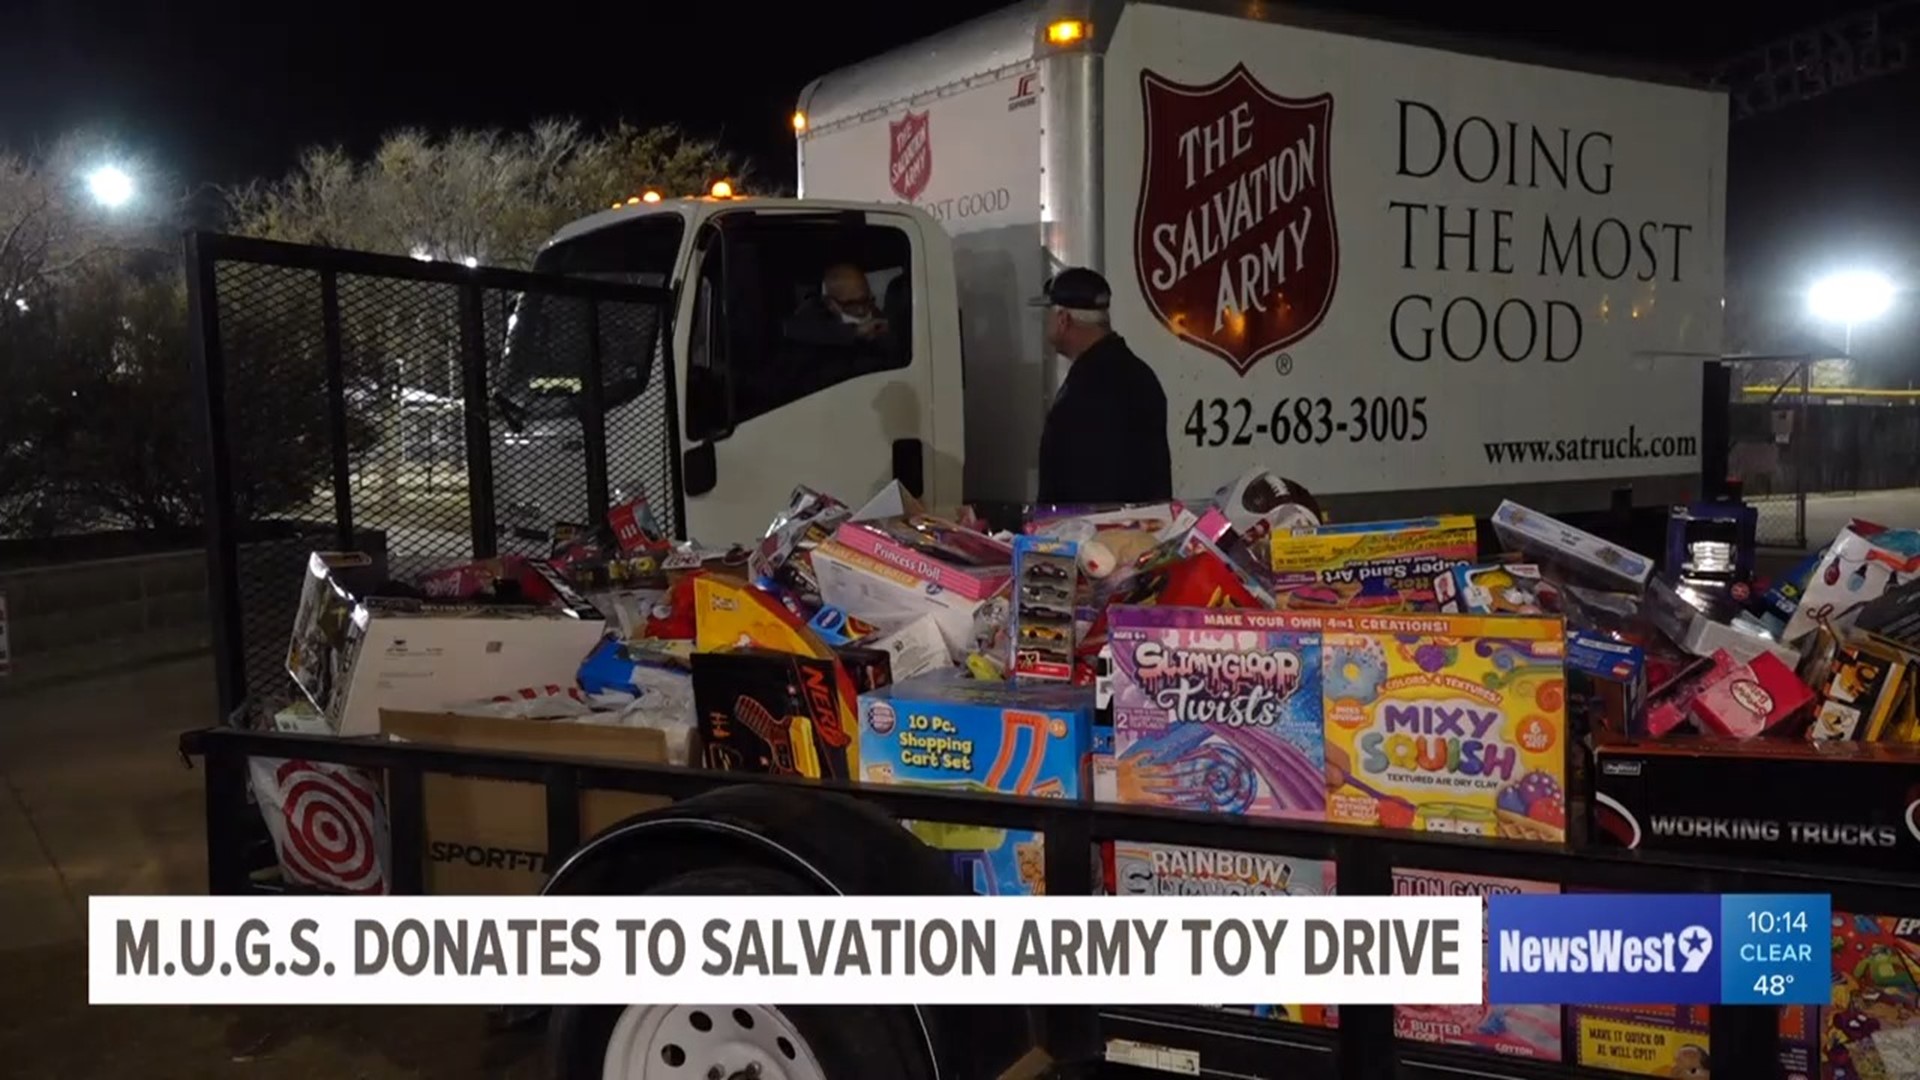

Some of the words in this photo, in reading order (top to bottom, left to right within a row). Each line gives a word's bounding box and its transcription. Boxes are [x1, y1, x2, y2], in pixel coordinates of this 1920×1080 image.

[1179, 101, 1254, 189] THE
[1395, 99, 1614, 195] DOING
[925, 199, 954, 221] OST
[958, 187, 1010, 218] GOOD
[1151, 124, 1316, 292] SALVATION
[1389, 201, 1514, 274] THE
[1537, 214, 1694, 283] MOST
[1211, 206, 1313, 335] ARMY
[1390, 295, 1584, 363] GOOD
[1184, 396, 1429, 448] 432-683-3005
[1484, 425, 1698, 464] www.satruck.com
[873, 543, 916, 570] Princess
[918, 562, 941, 580] Doll
[1323, 568, 1356, 583] Art
[1359, 564, 1407, 580] Sand
[1204, 615, 1242, 626] MAKE
[1248, 616, 1284, 627] YOUR
[1291, 617, 1322, 628] OWN
[1360, 618, 1448, 632] CREATIONS!
[1135, 643, 1301, 690] SLIMYGLOOP
[1157, 678, 1279, 727] Twists
[909, 715, 928, 729] 10
[932, 717, 956, 732] Pc.
[1385, 705, 1498, 738] MIXY
[900, 732, 972, 754] Shopping
[901, 751, 939, 767] Cart
[943, 753, 972, 770] Set
[1361, 732, 1516, 781] SQUISH
[1387, 773, 1434, 785] TEXTURED
[1436, 776, 1453, 786] AIR
[1454, 777, 1472, 787] DRY
[1474, 778, 1498, 789] CLAY
[1651, 815, 1779, 840] WORKING
[1788, 822, 1896, 846] TRUCKS
[1151, 850, 1288, 886] RAINBOW
